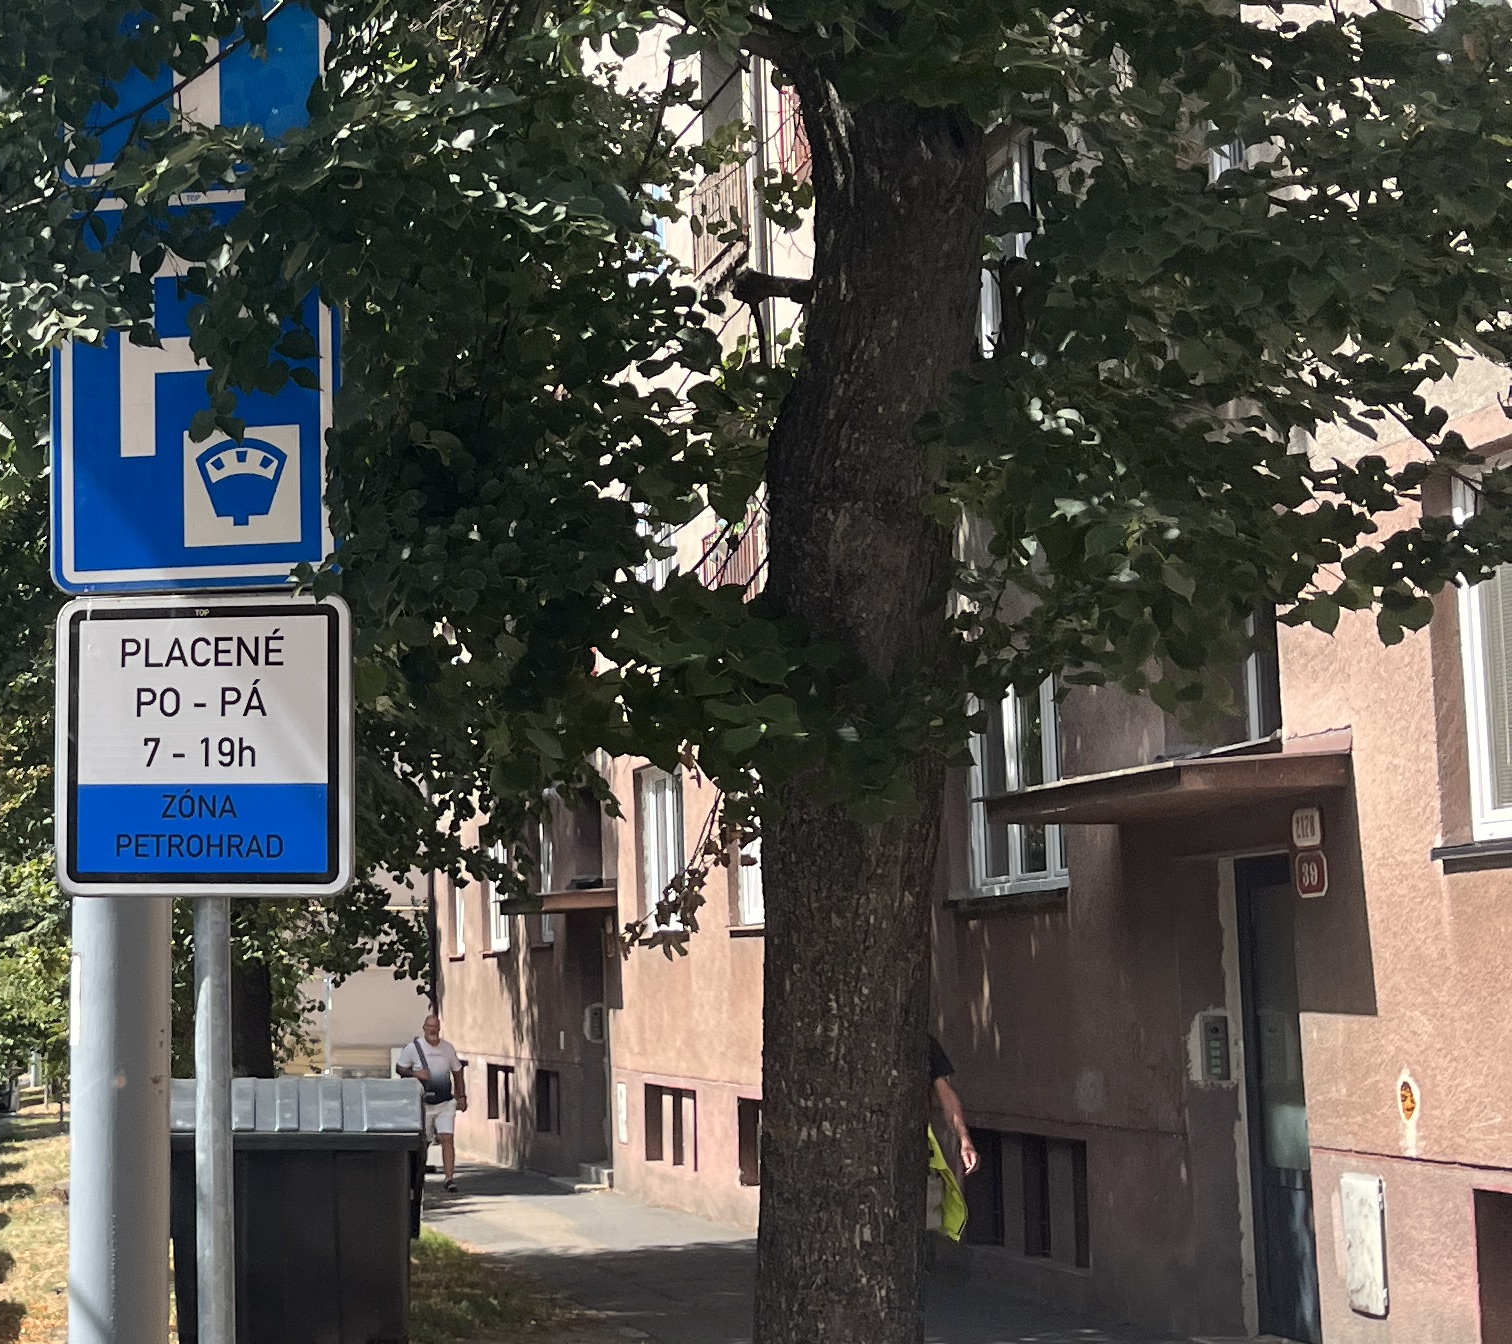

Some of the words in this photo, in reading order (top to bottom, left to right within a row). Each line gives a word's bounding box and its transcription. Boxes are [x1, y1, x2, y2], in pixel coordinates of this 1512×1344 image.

[121, 628, 284, 668] PLACENÉ
[136, 687, 180, 717] PO
[221, 679, 267, 717] PÁ
[143, 737, 160, 767] 7
[200, 737, 256, 767] 19h
[161, 788, 237, 819] ZÓNA
[116, 834, 284, 858] PETROHRAD
[1301, 862, 1318, 886] 39
